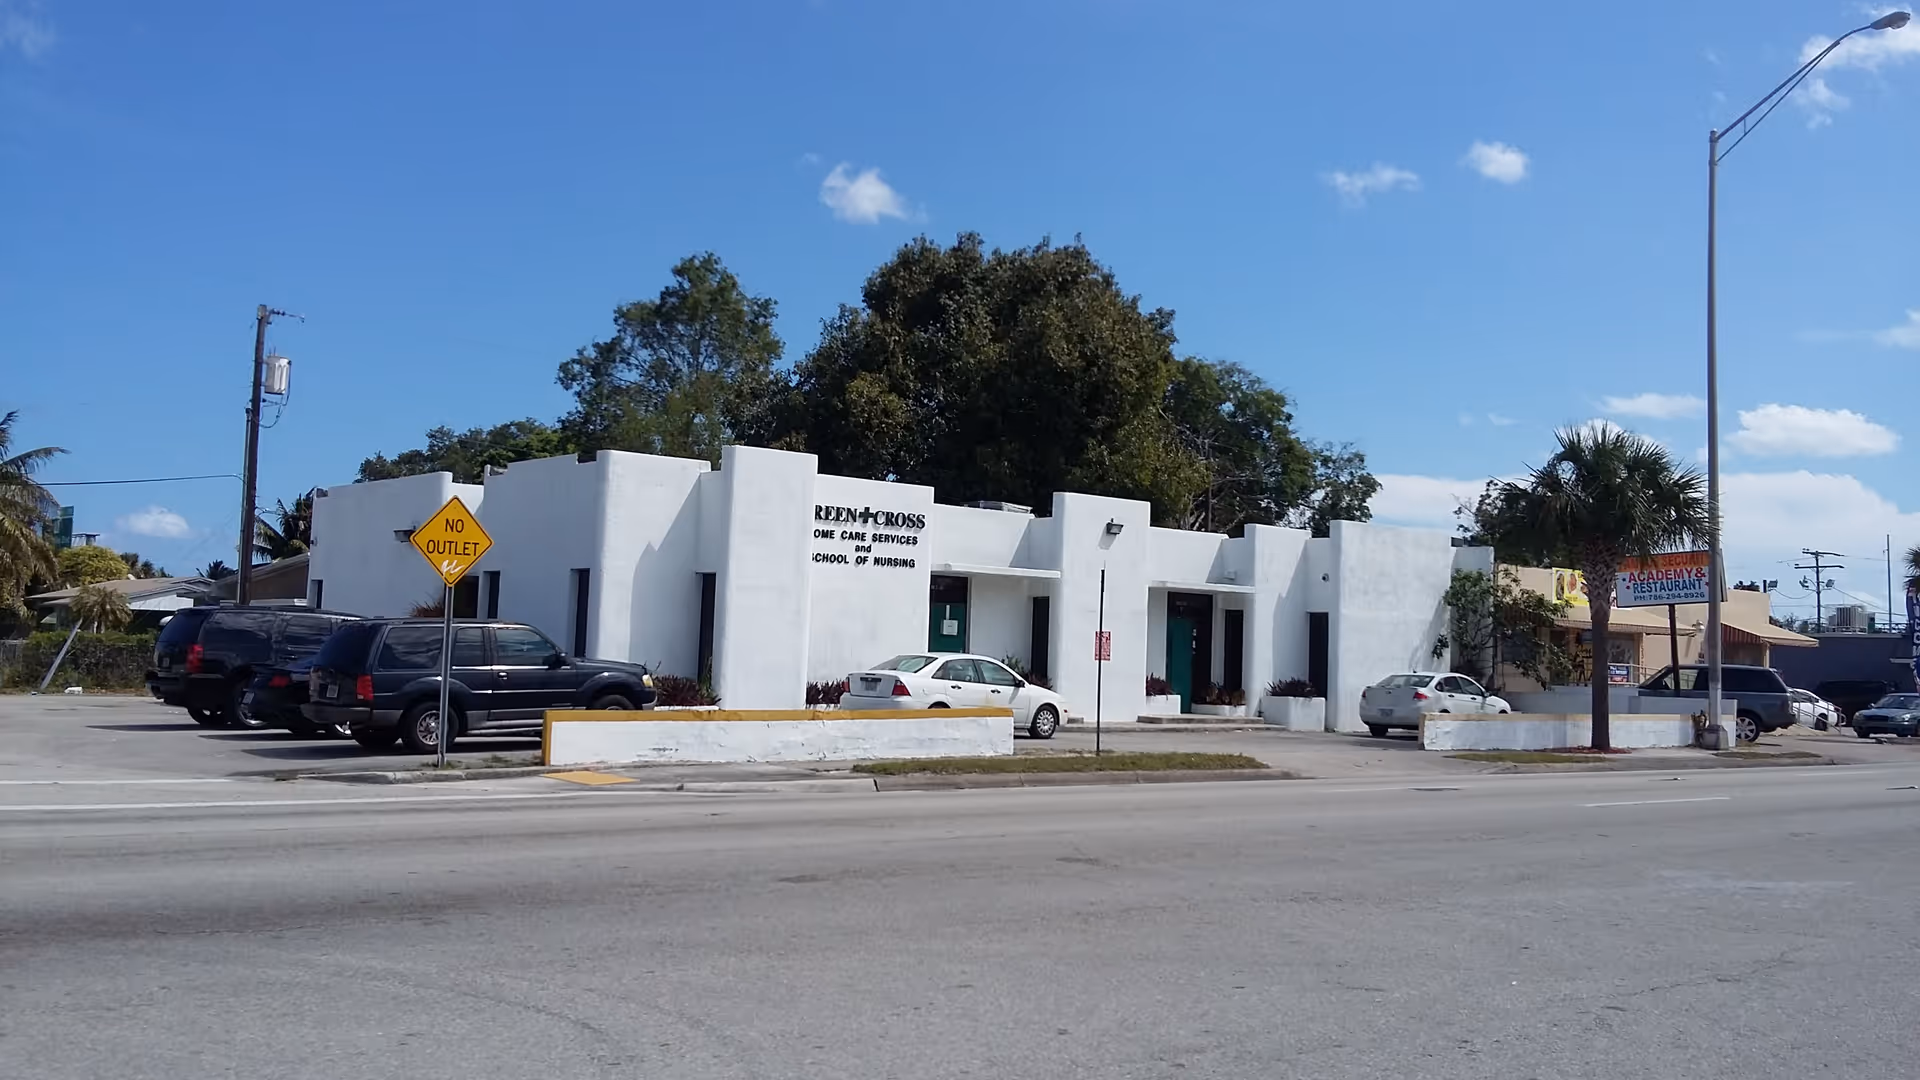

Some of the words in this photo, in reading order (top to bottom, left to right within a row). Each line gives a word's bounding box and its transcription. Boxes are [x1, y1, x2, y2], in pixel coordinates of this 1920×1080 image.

[814, 504, 858, 523] REEN
[873, 510, 926, 529] CROSS
[445, 518, 465, 533] NO
[813, 529, 835, 539] OME
[840, 530, 867, 541] CARE
[872, 533, 918, 545] SERVICES
[426, 539, 480, 556] OUTLET
[854, 544, 872, 553] and
[855, 555, 869, 565] OF
[873, 556, 916, 568] NURSING
[1662, 553, 1704, 568] SECURIT
[1633, 579, 1703, 594] RESTAURANT
